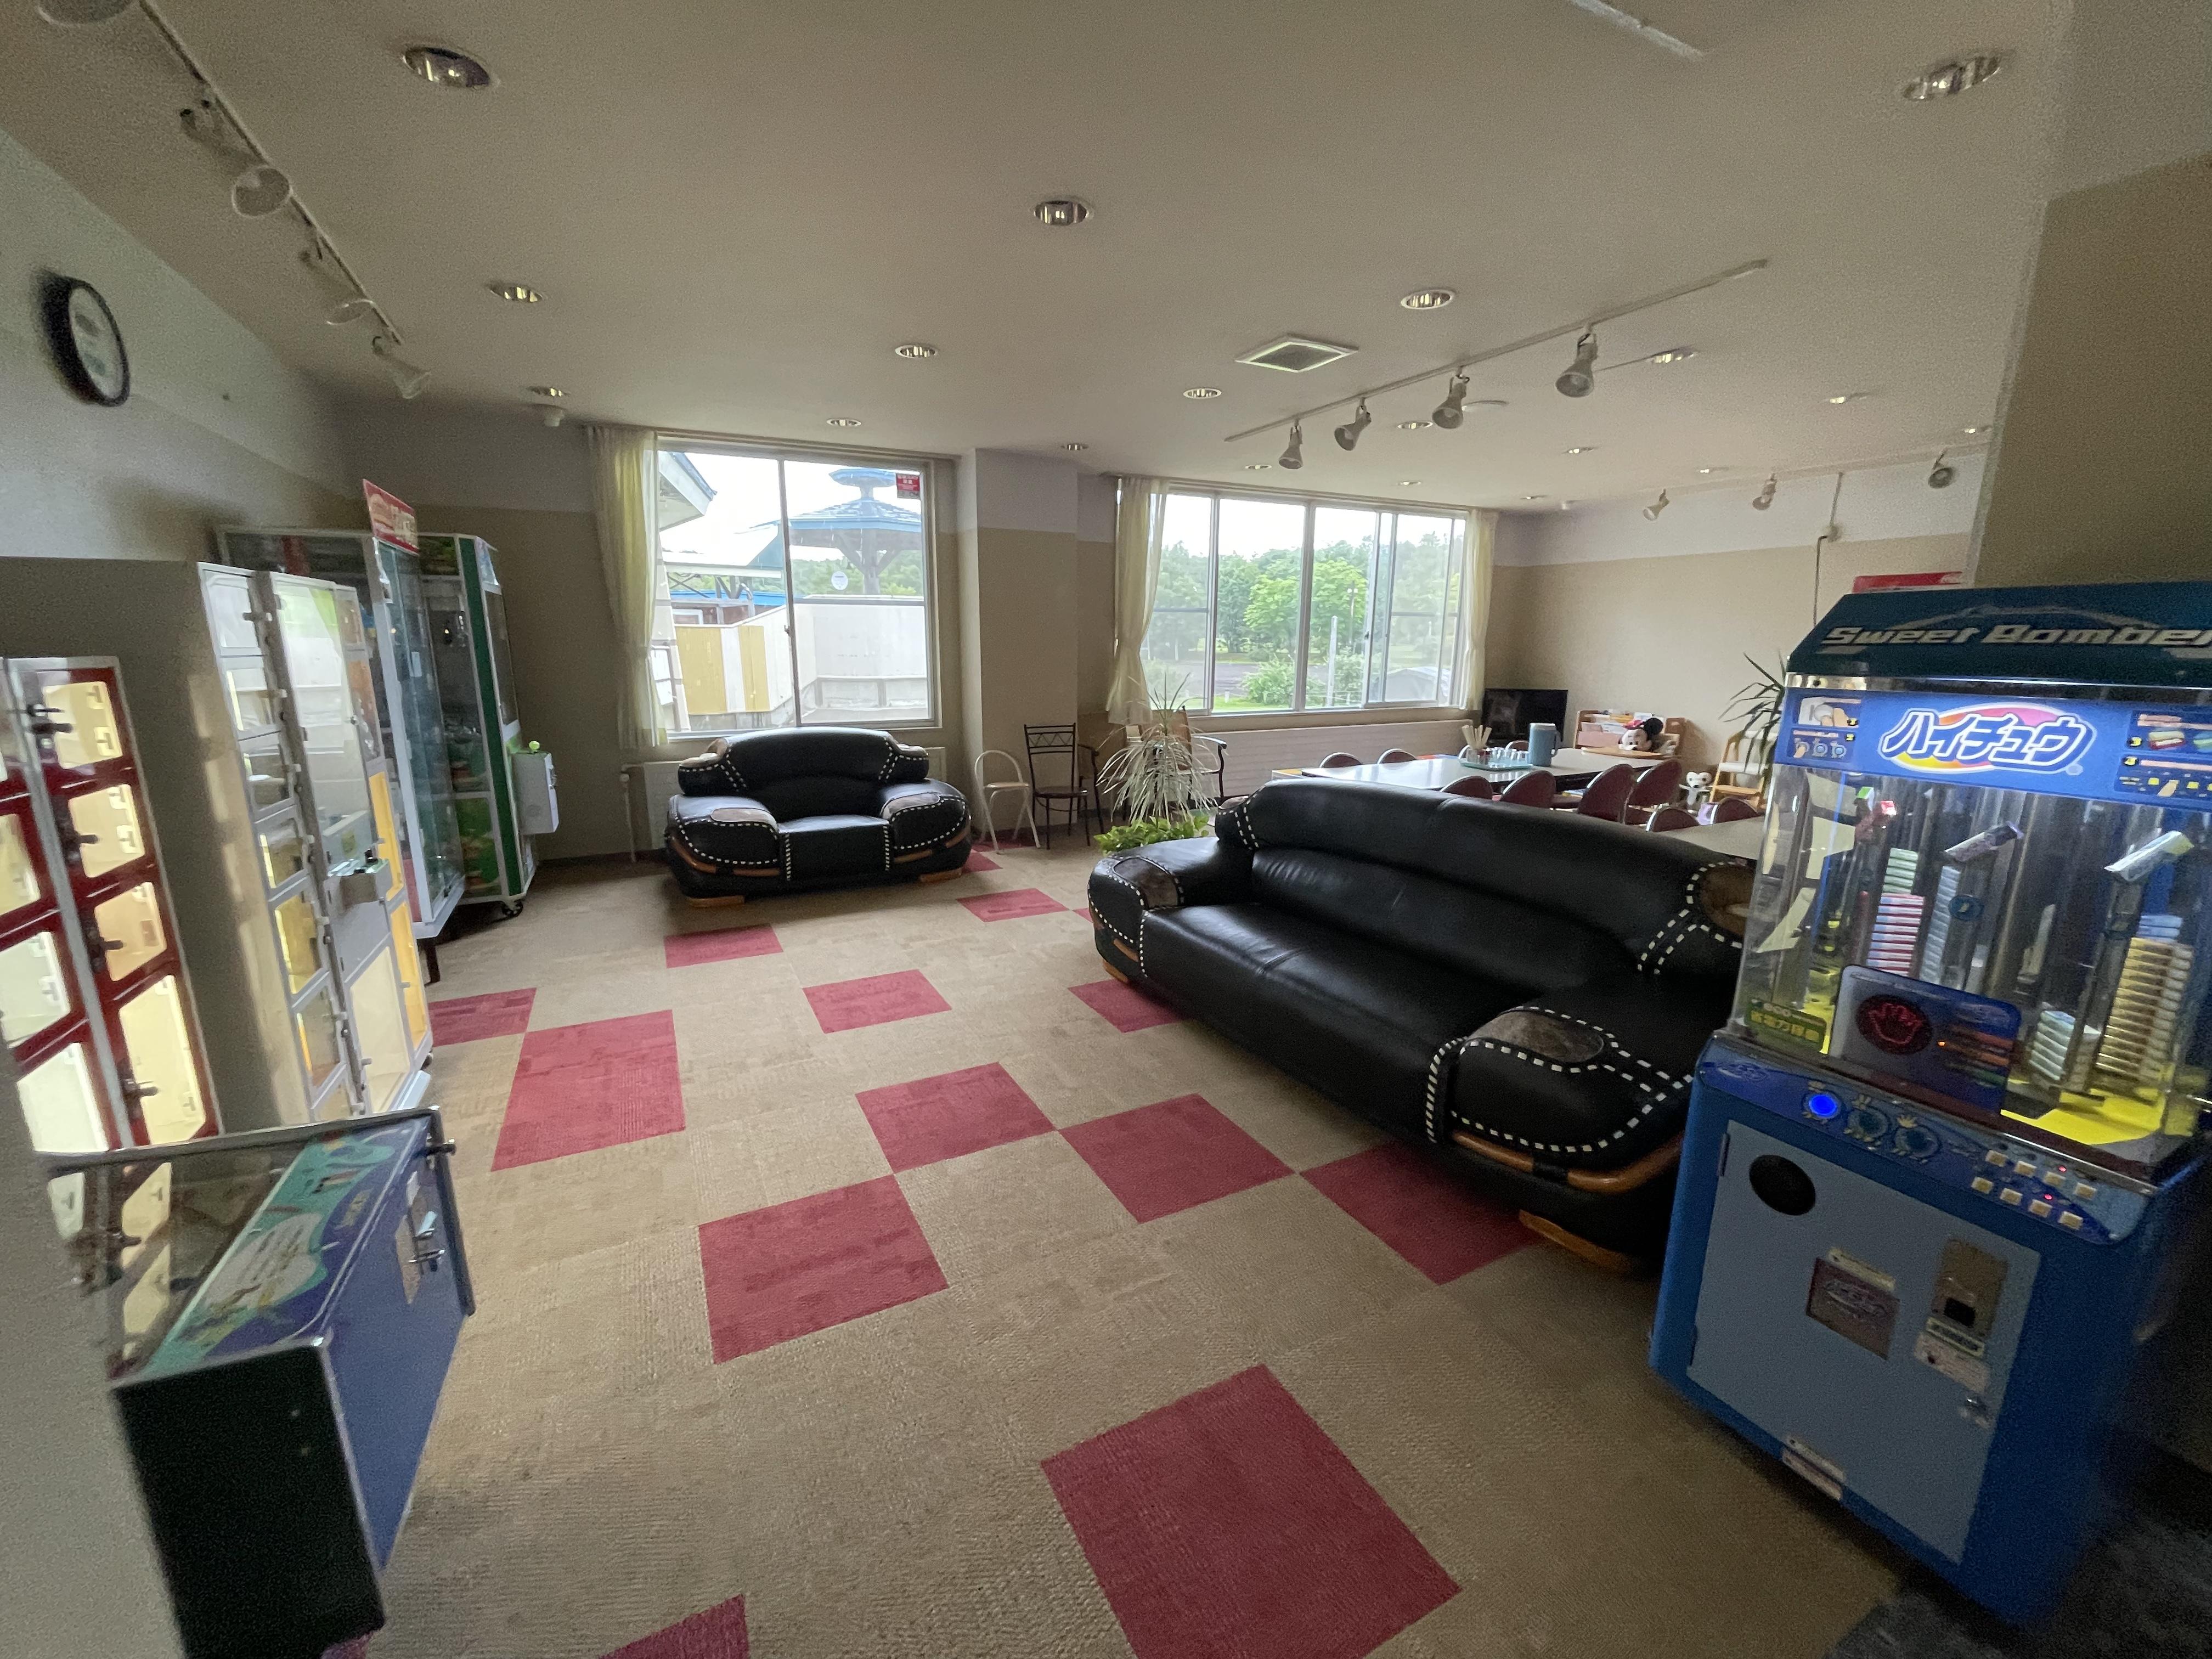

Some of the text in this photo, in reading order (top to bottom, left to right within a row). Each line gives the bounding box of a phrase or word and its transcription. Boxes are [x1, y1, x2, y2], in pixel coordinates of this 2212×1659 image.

[1881, 710, 2090, 769] ハイチュウ
